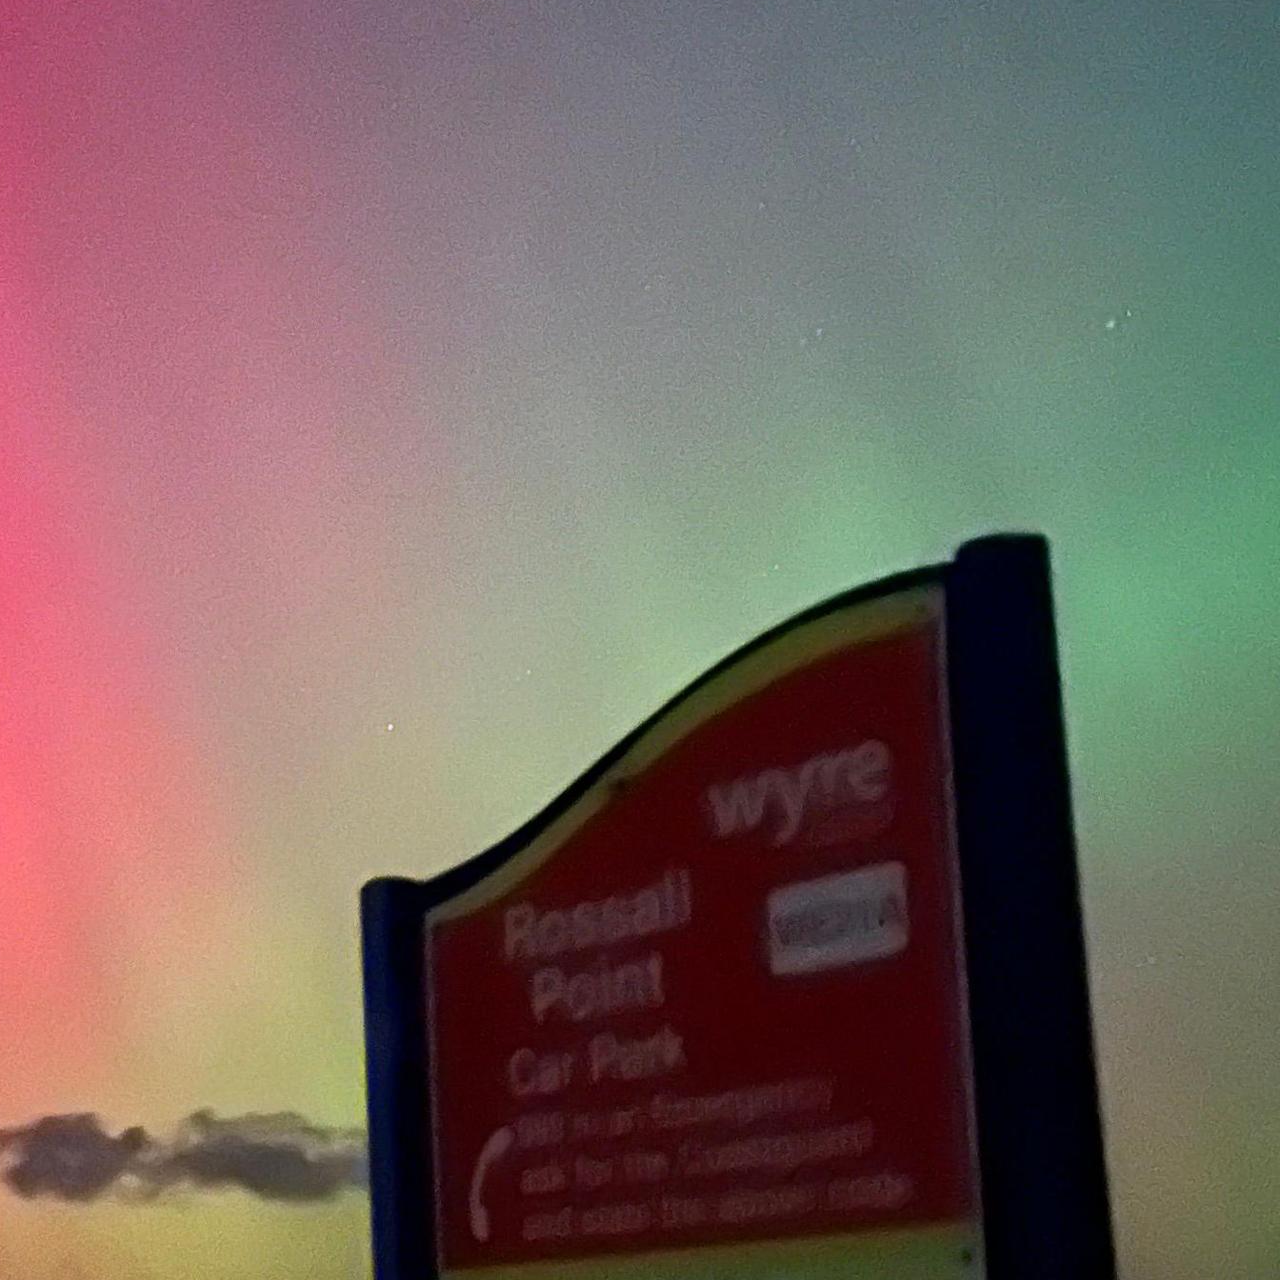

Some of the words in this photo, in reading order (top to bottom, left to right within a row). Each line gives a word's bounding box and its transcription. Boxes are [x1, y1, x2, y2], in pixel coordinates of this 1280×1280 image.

[708, 739, 892, 848] wyre
[504, 866, 693, 961] Rossall
[531, 950, 666, 1023] Point
[508, 1046, 575, 1097] Car
[587, 1023, 688, 1082] Park
